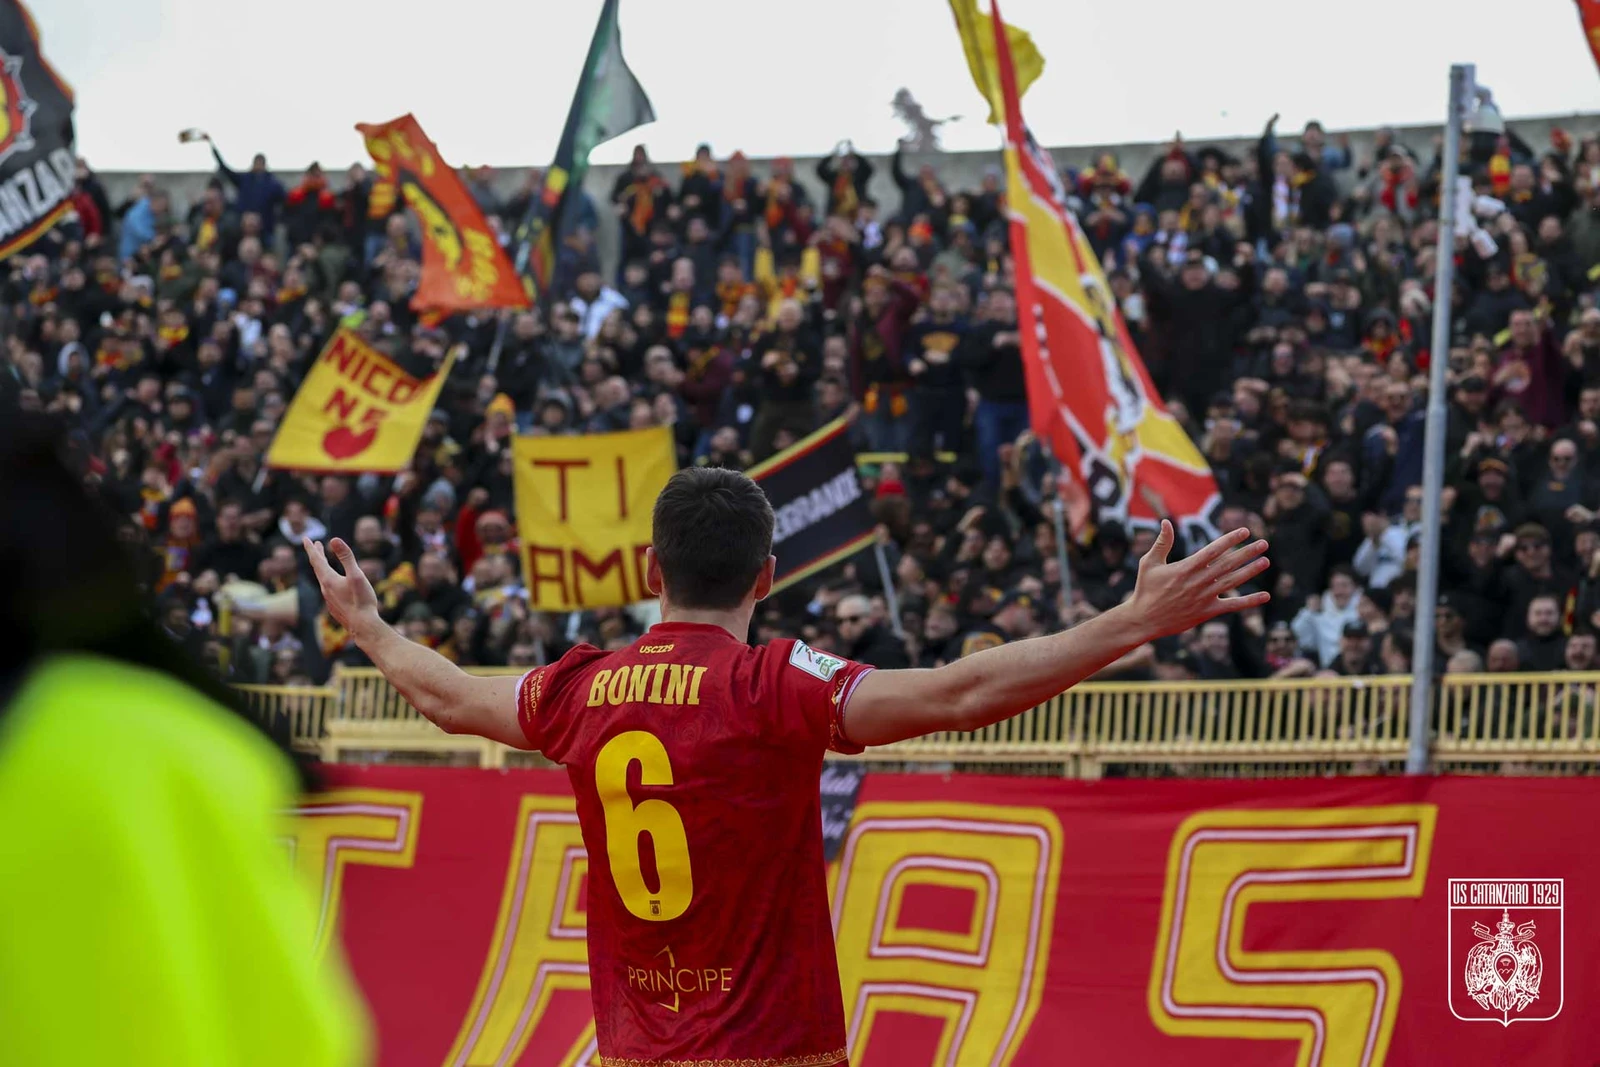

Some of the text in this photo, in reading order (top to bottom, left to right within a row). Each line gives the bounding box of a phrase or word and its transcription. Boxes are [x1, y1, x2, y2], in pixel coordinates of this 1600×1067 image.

[324, 336, 421, 405] NICO
[586, 663, 708, 708] BONINI
[595, 730, 693, 922] 6
[628, 966, 733, 993] PRINCIPE
